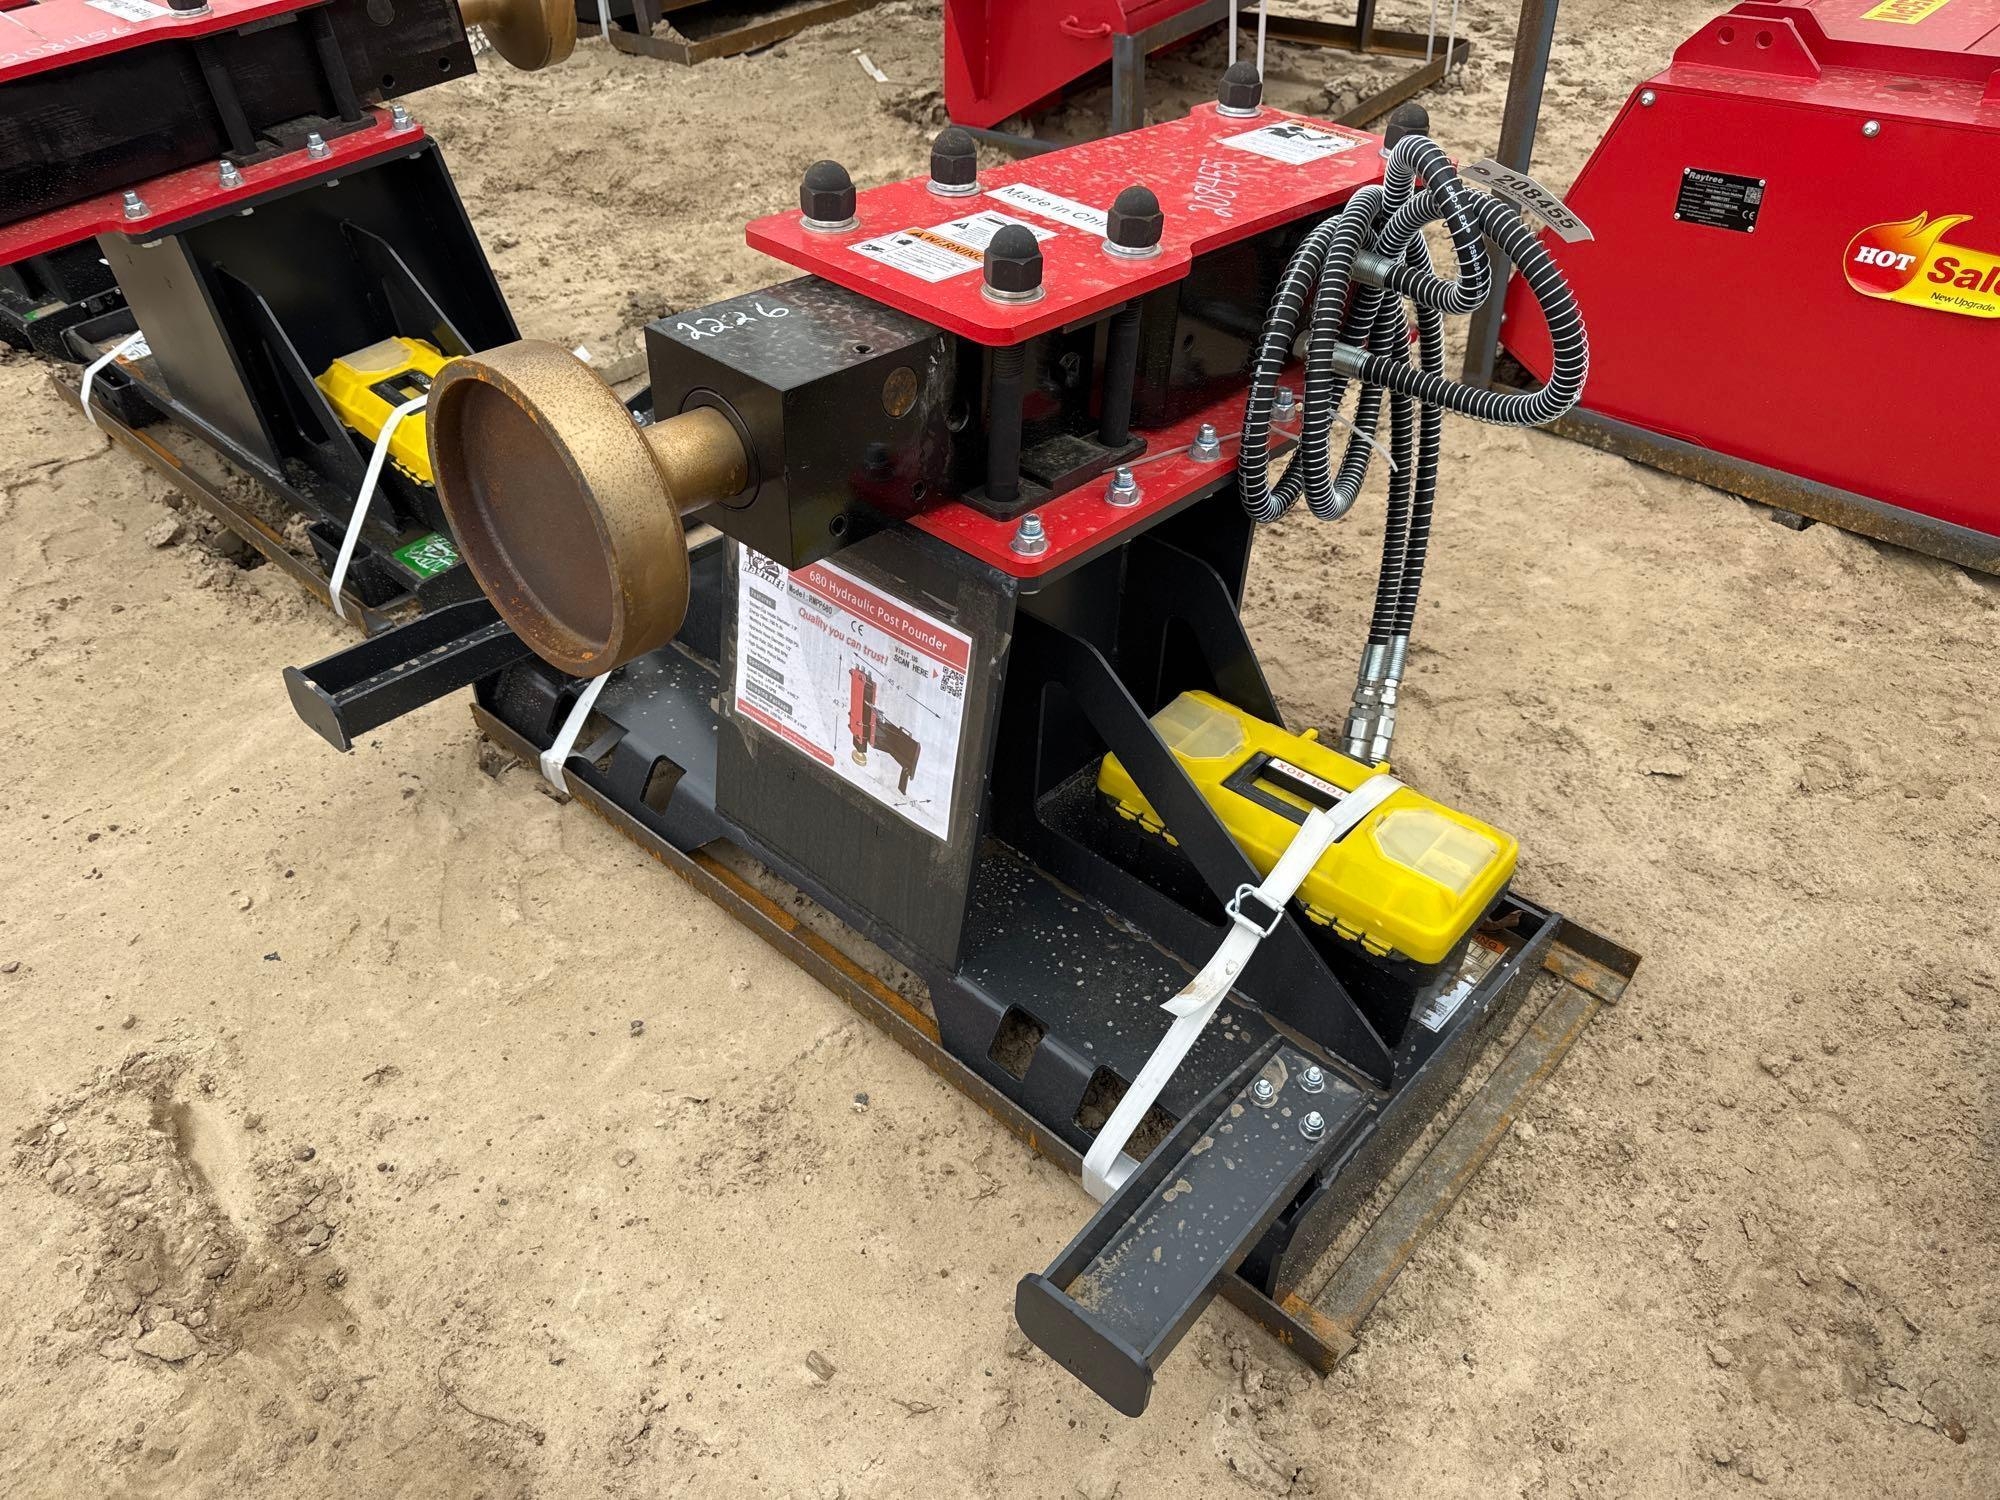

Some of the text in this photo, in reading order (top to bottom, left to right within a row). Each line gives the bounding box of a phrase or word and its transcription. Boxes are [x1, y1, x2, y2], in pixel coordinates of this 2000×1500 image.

[1188, 158, 1240, 218] 208455
[1688, 171, 1724, 184] Raytree
[1002, 187, 1051, 207] Made
[1051, 204, 1071, 214] in
[1494, 174, 1578, 229] 208455
[1854, 245, 1917, 271] HOT
[1930, 292, 1996, 313] New Upgrade
[677, 302, 790, 340] 2226
[809, 570, 948, 652] 680 Hydraulic Post Pounder
[799, 607, 828, 633] Quality
[829, 624, 845, 641] you
[846, 635, 862, 651] can
[864, 644, 889, 667] trust!
[893, 653, 930, 679] SCAN HERE
[894, 646, 910, 660] VISIT
[1278, 763, 1345, 798] TOOL BOX
